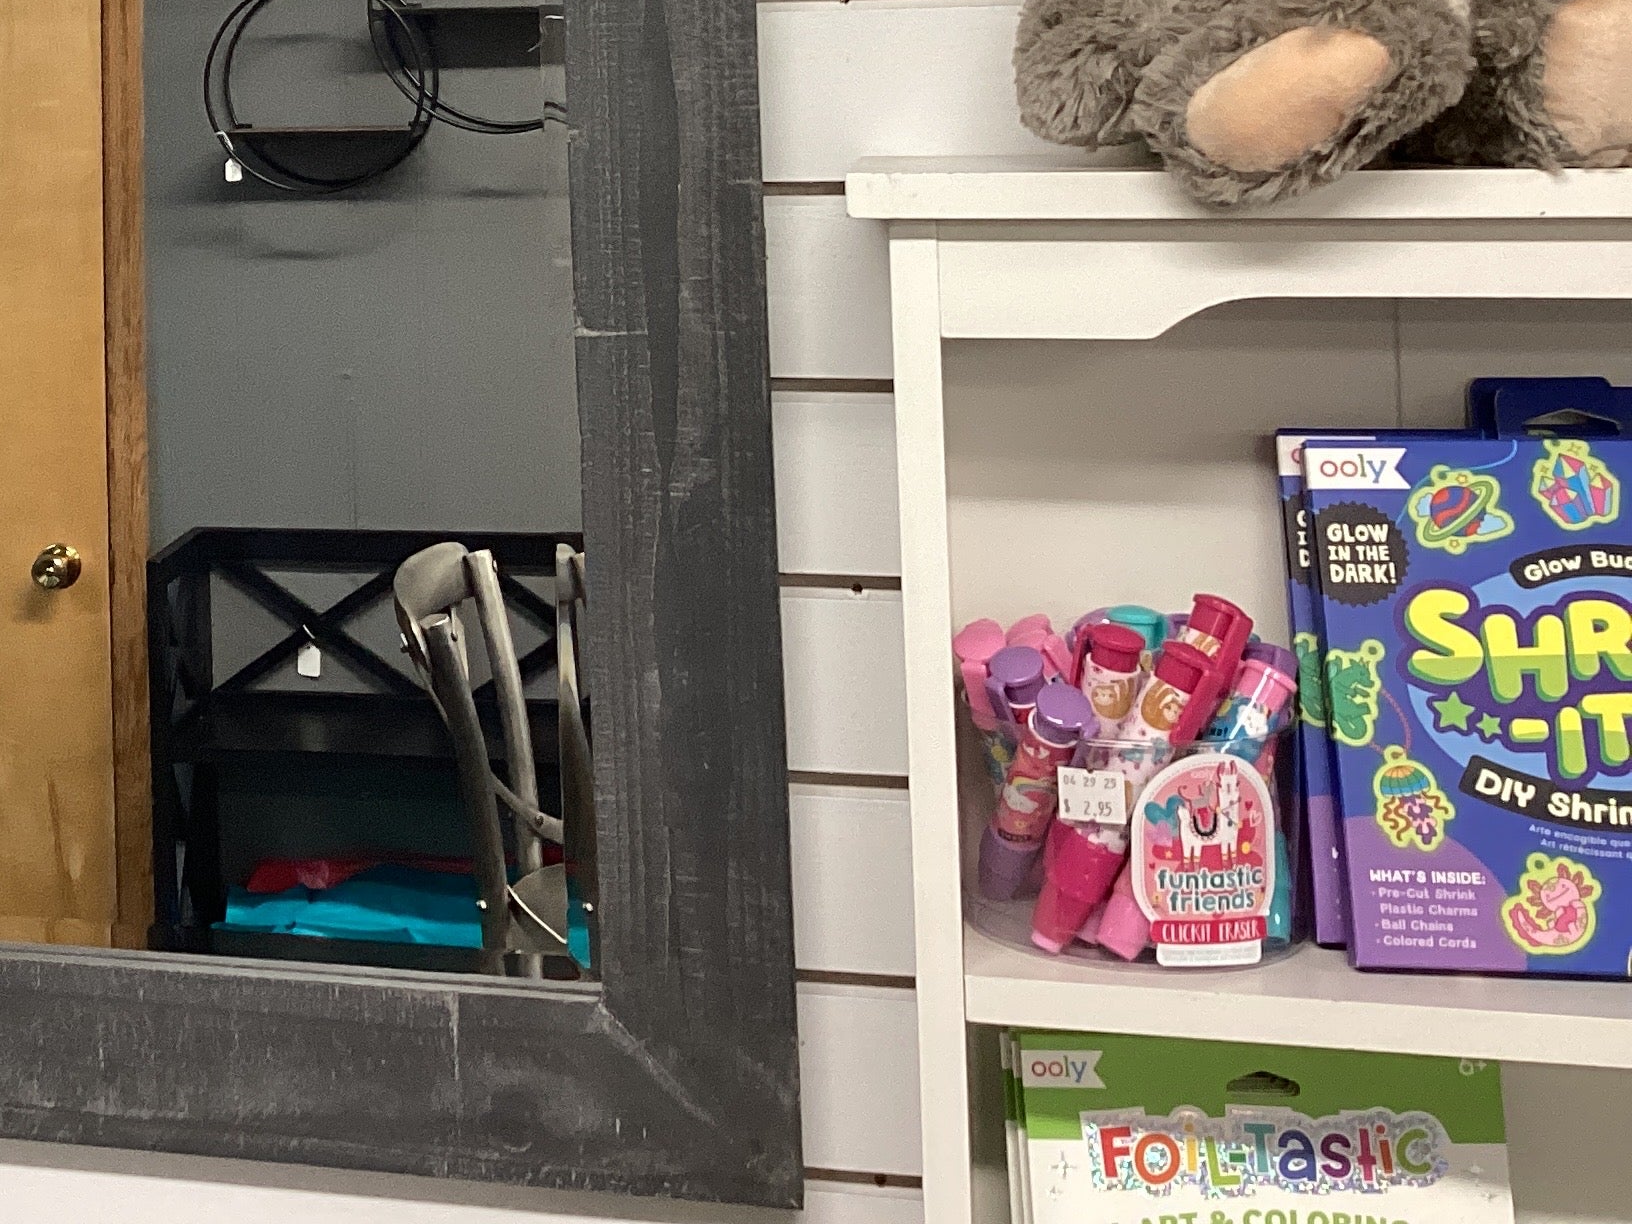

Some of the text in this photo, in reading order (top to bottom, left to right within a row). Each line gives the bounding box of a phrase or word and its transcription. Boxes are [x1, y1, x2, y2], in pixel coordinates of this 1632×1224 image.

[1320, 453, 1387, 484] ooly
[1326, 523, 1389, 543] GLOW
[1327, 545, 1351, 561] IN
[1355, 545, 1390, 561] THE
[1329, 562, 1397, 584] DARK!
[1523, 555, 1581, 581] Glow
[1063, 774, 1076, 785] 04
[1083, 776, 1096, 787] 29
[1475, 768, 1536, 807] DIY
[1083, 800, 1112, 817] 2.95
[1540, 838, 1556, 849] Art
[1158, 866, 1263, 889] funtastic
[1369, 869, 1486, 885] WHAT'S INSIDE:
[1169, 890, 1254, 912] friends
[1378, 887, 1476, 900] Pre-Cut Shrink
[1380, 903, 1478, 916] Plastic Charms
[1162, 919, 1260, 943] CLICKIT ERASER
[1381, 918, 1453, 932] Ball Chains
[1383, 935, 1476, 949] Colored Cords
[1031, 1055, 1087, 1083] ooly
